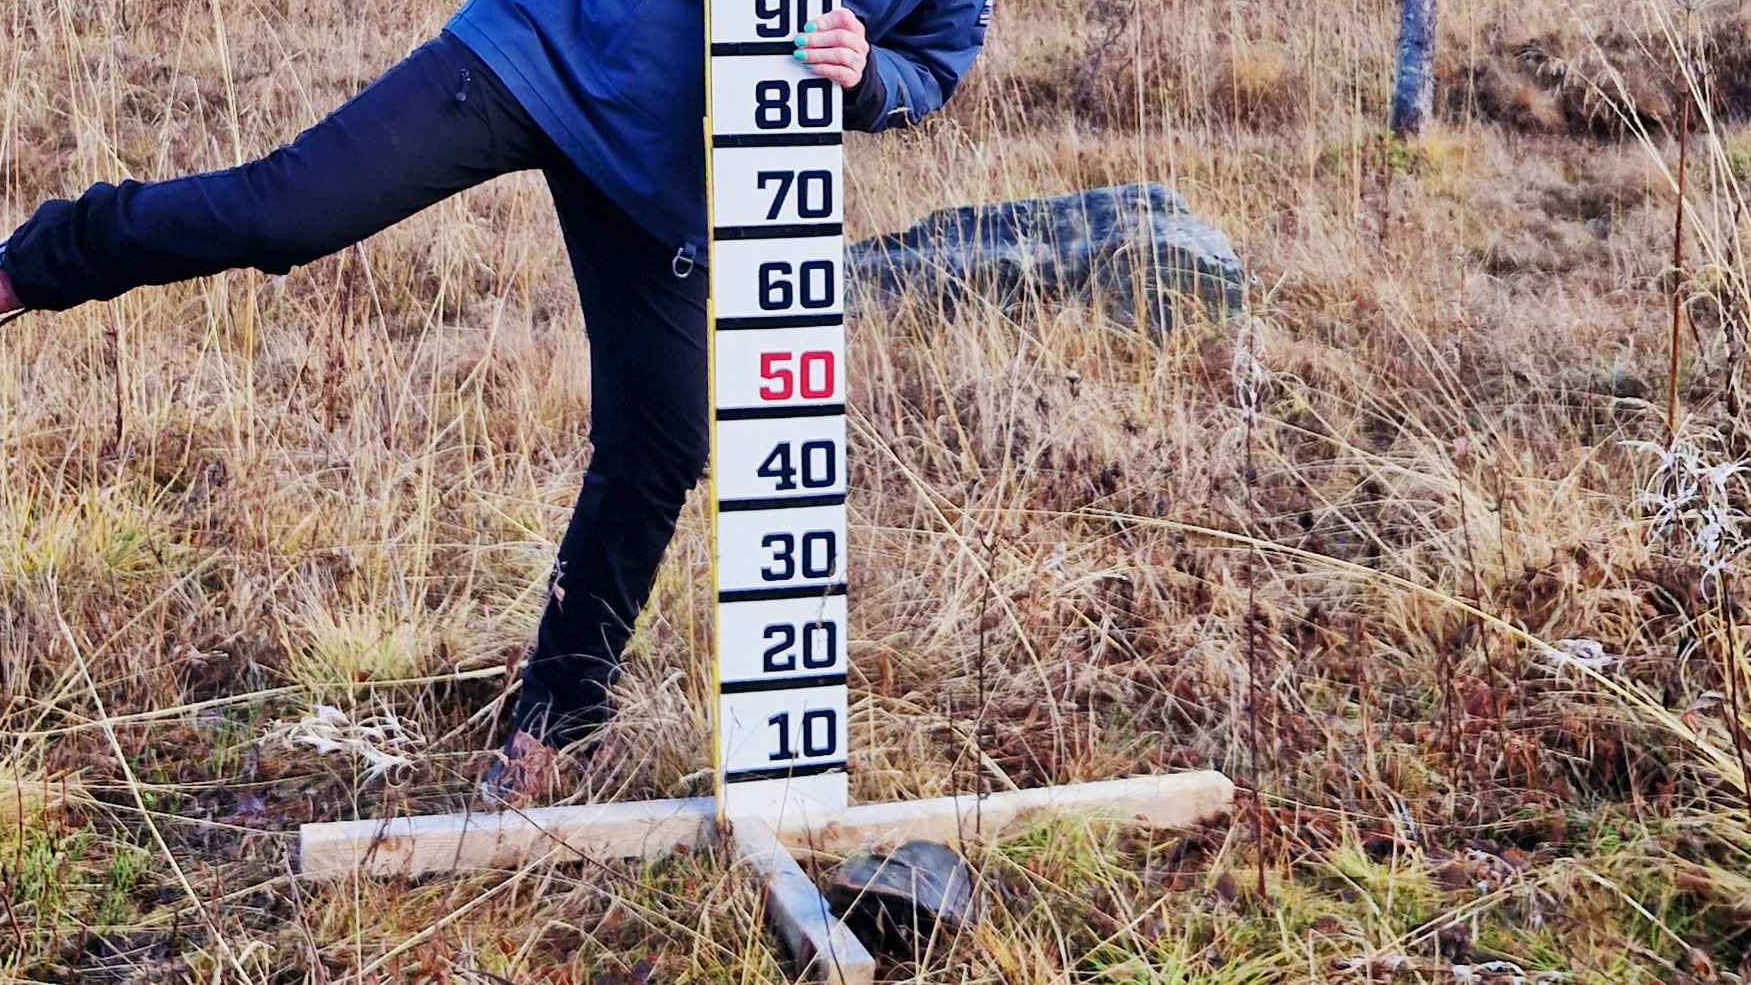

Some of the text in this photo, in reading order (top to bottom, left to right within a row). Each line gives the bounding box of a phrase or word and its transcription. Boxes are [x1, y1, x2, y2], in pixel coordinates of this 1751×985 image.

[755, 78, 833, 130] 80
[757, 169, 833, 221] 70
[758, 260, 835, 311] 60
[759, 350, 835, 401] 50
[757, 439, 837, 491] 40
[761, 530, 837, 582] 30
[762, 619, 837, 673] 20
[767, 708, 837, 761] 10
